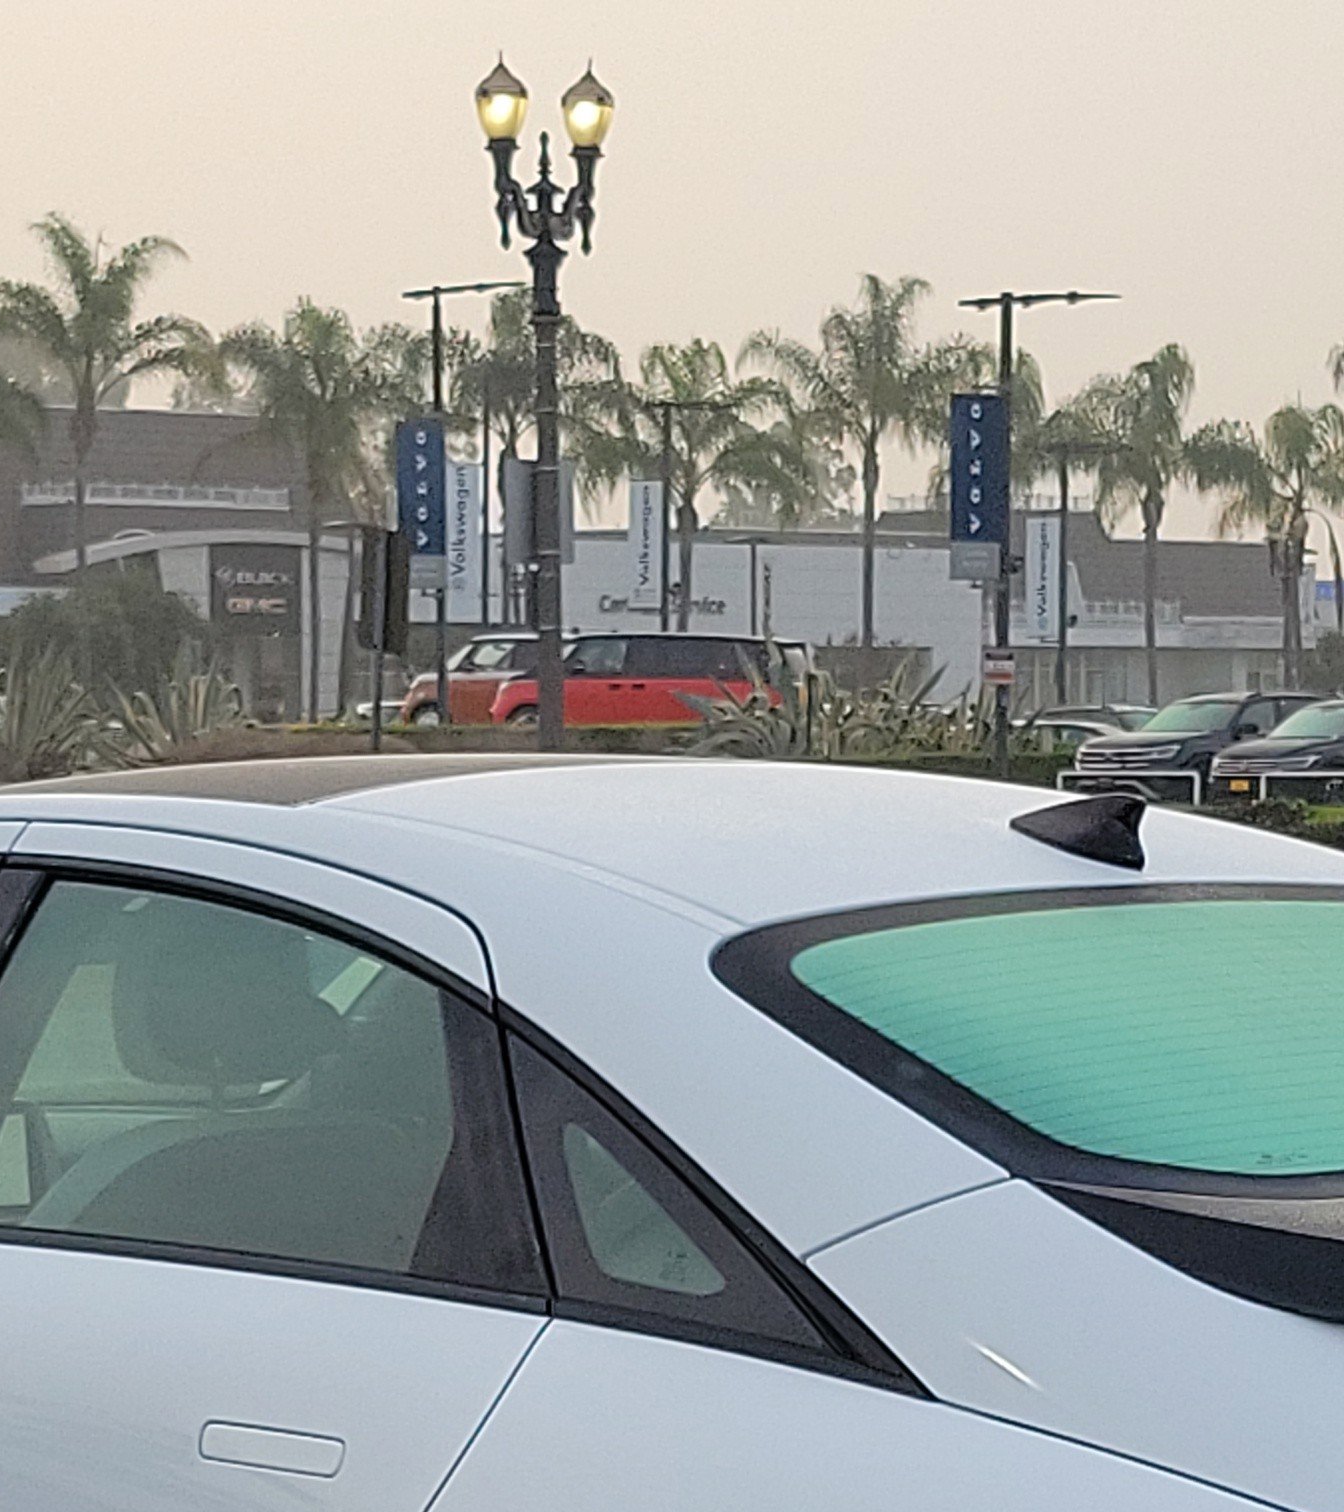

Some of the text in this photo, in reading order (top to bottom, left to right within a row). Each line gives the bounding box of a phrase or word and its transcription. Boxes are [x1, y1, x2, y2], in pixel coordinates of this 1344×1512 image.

[415, 430, 429, 548] VOLVO
[451, 465, 470, 575] Volkswagen
[969, 403, 982, 534] VOLVO
